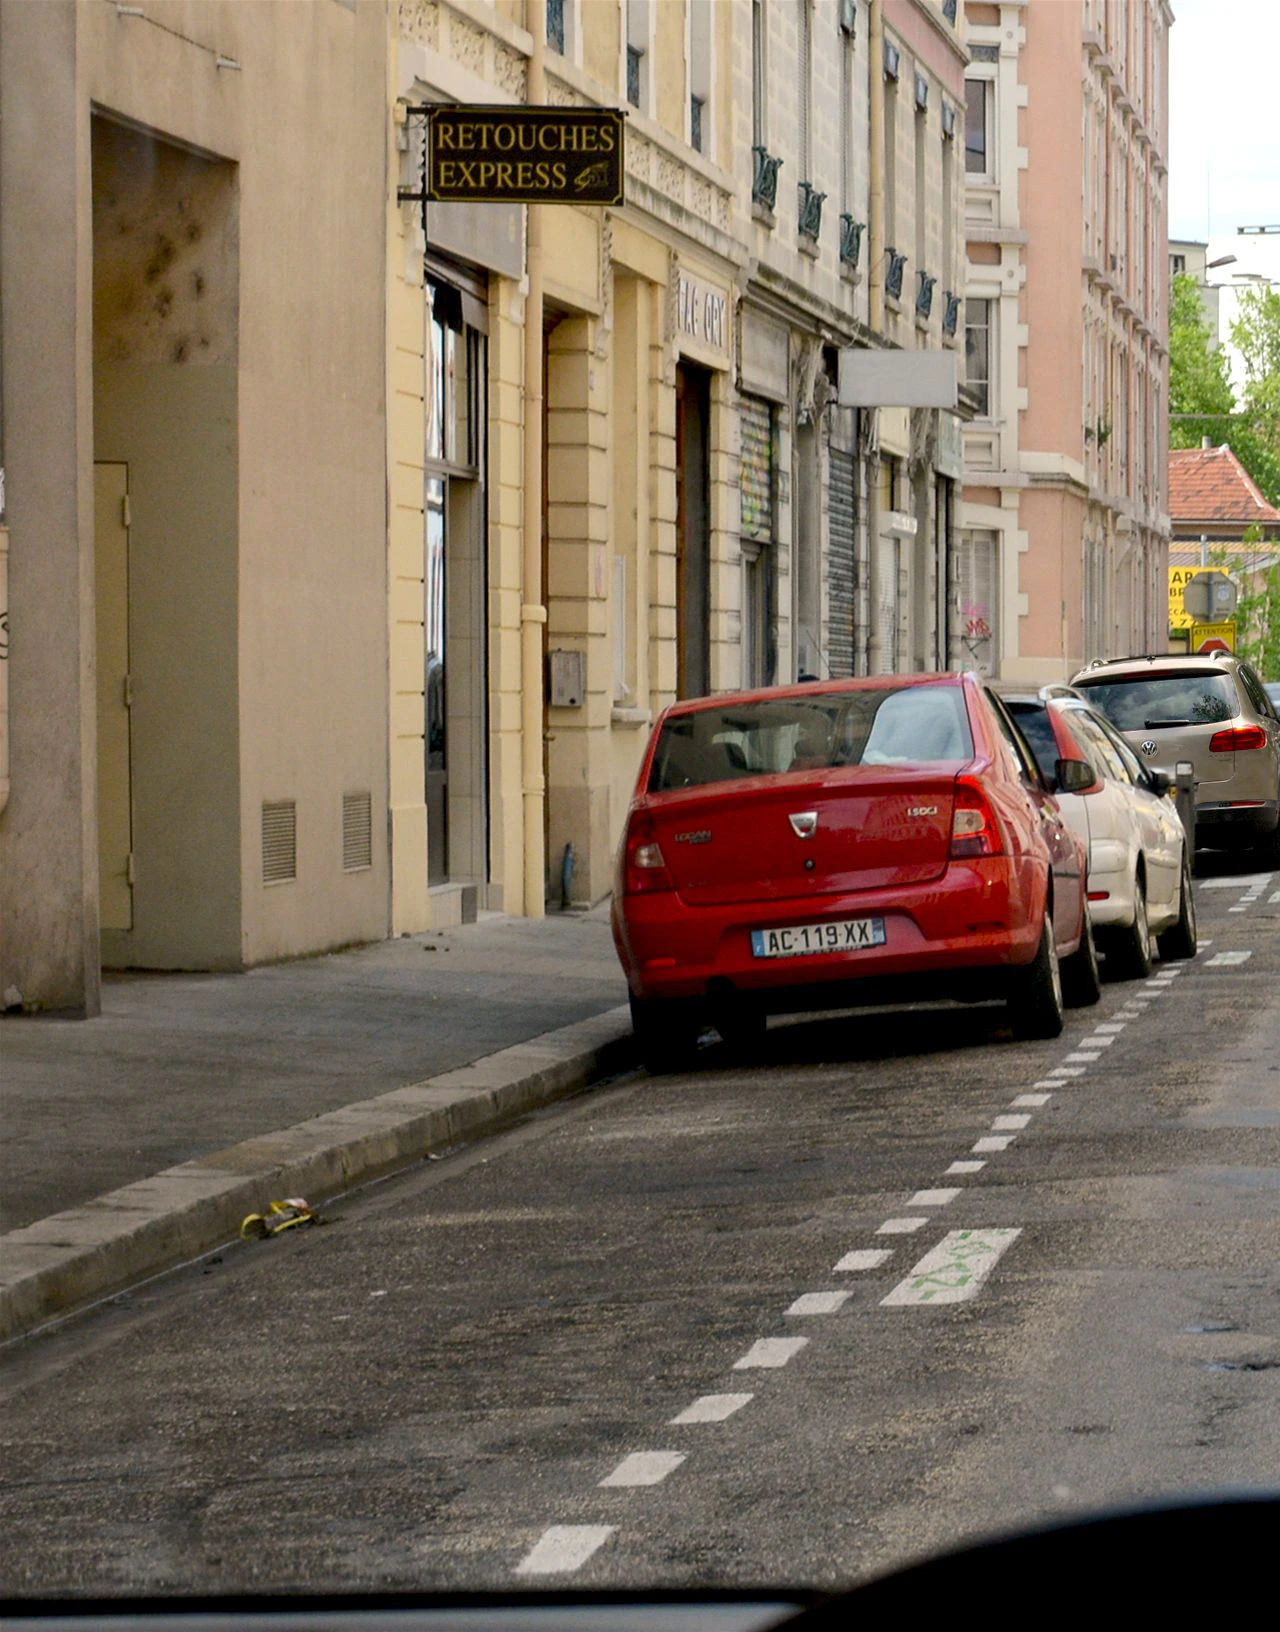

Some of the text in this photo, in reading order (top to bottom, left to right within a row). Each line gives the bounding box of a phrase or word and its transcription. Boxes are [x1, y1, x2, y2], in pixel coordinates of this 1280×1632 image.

[437, 123, 615, 152] RETOUCHES
[438, 161, 567, 189] EXPRESS
[1194, 627, 1233, 636] ATTENTION
